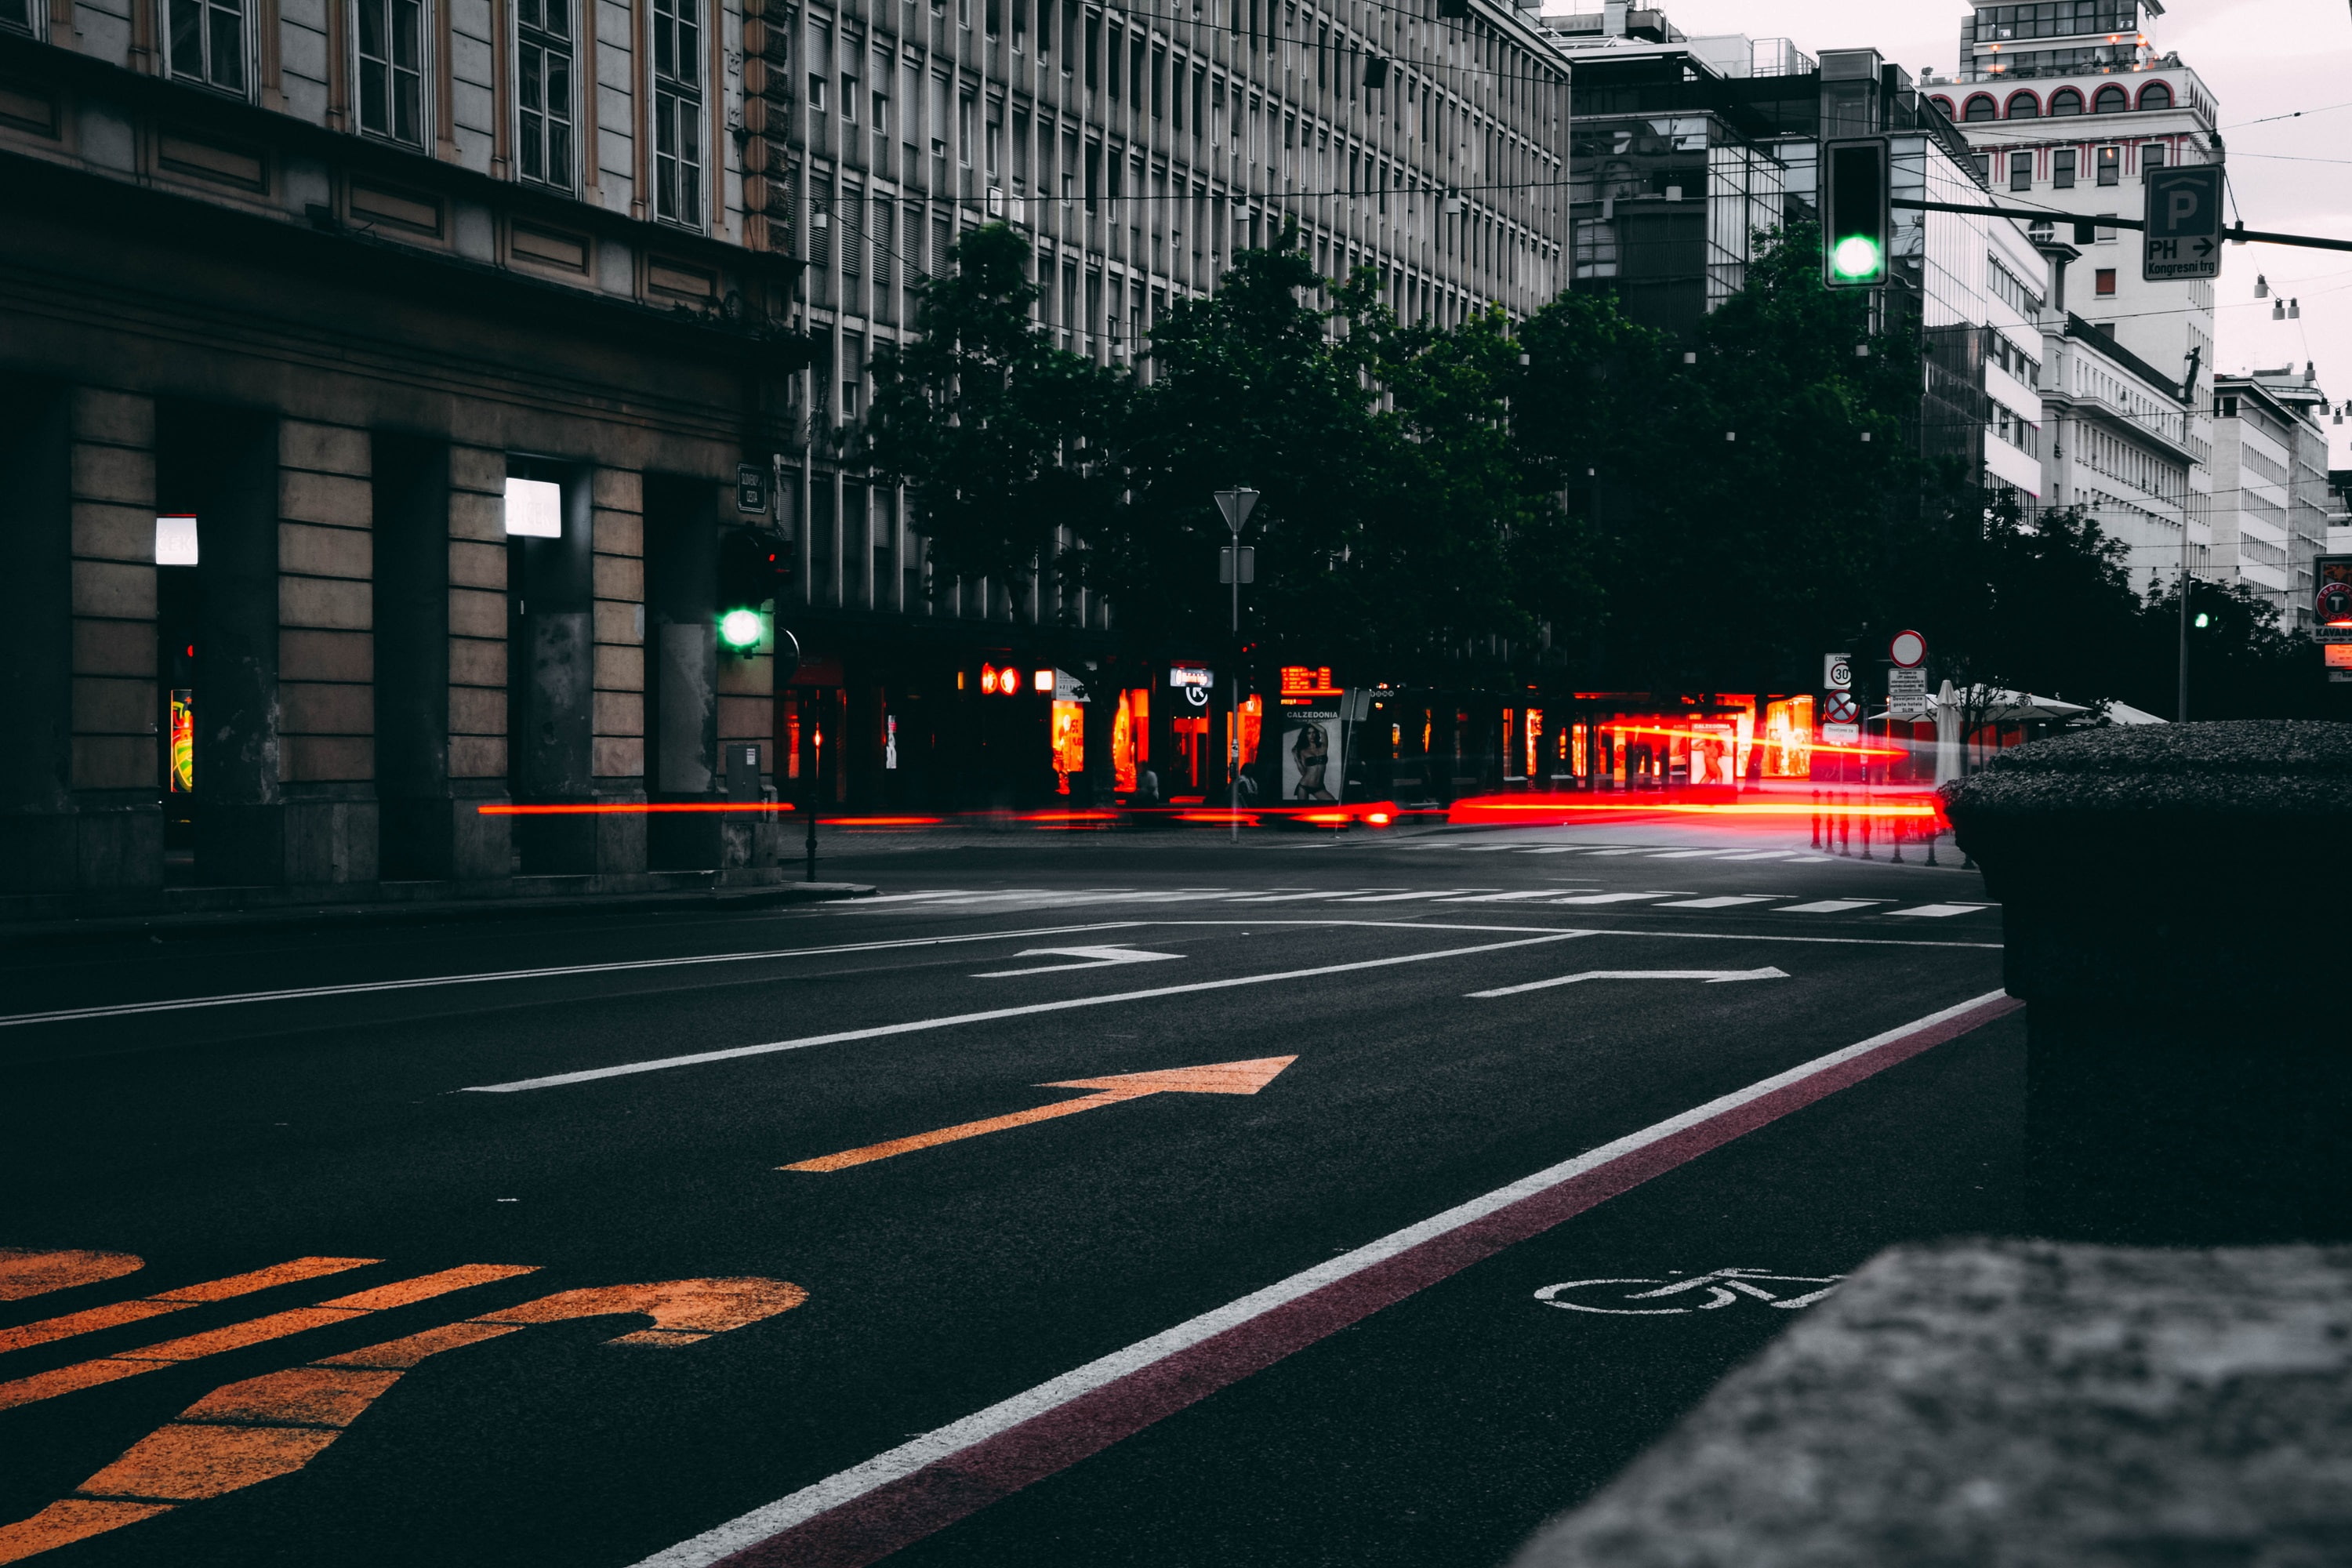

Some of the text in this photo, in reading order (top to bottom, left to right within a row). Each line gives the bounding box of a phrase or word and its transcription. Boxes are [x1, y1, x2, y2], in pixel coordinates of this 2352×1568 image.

[2168, 190, 2198, 230] P
[2148, 239, 2177, 260] PH
[2148, 260, 2215, 276] Kongresni trg
[2330, 596, 2344, 612] T
[1835, 668, 1849, 680] 30
